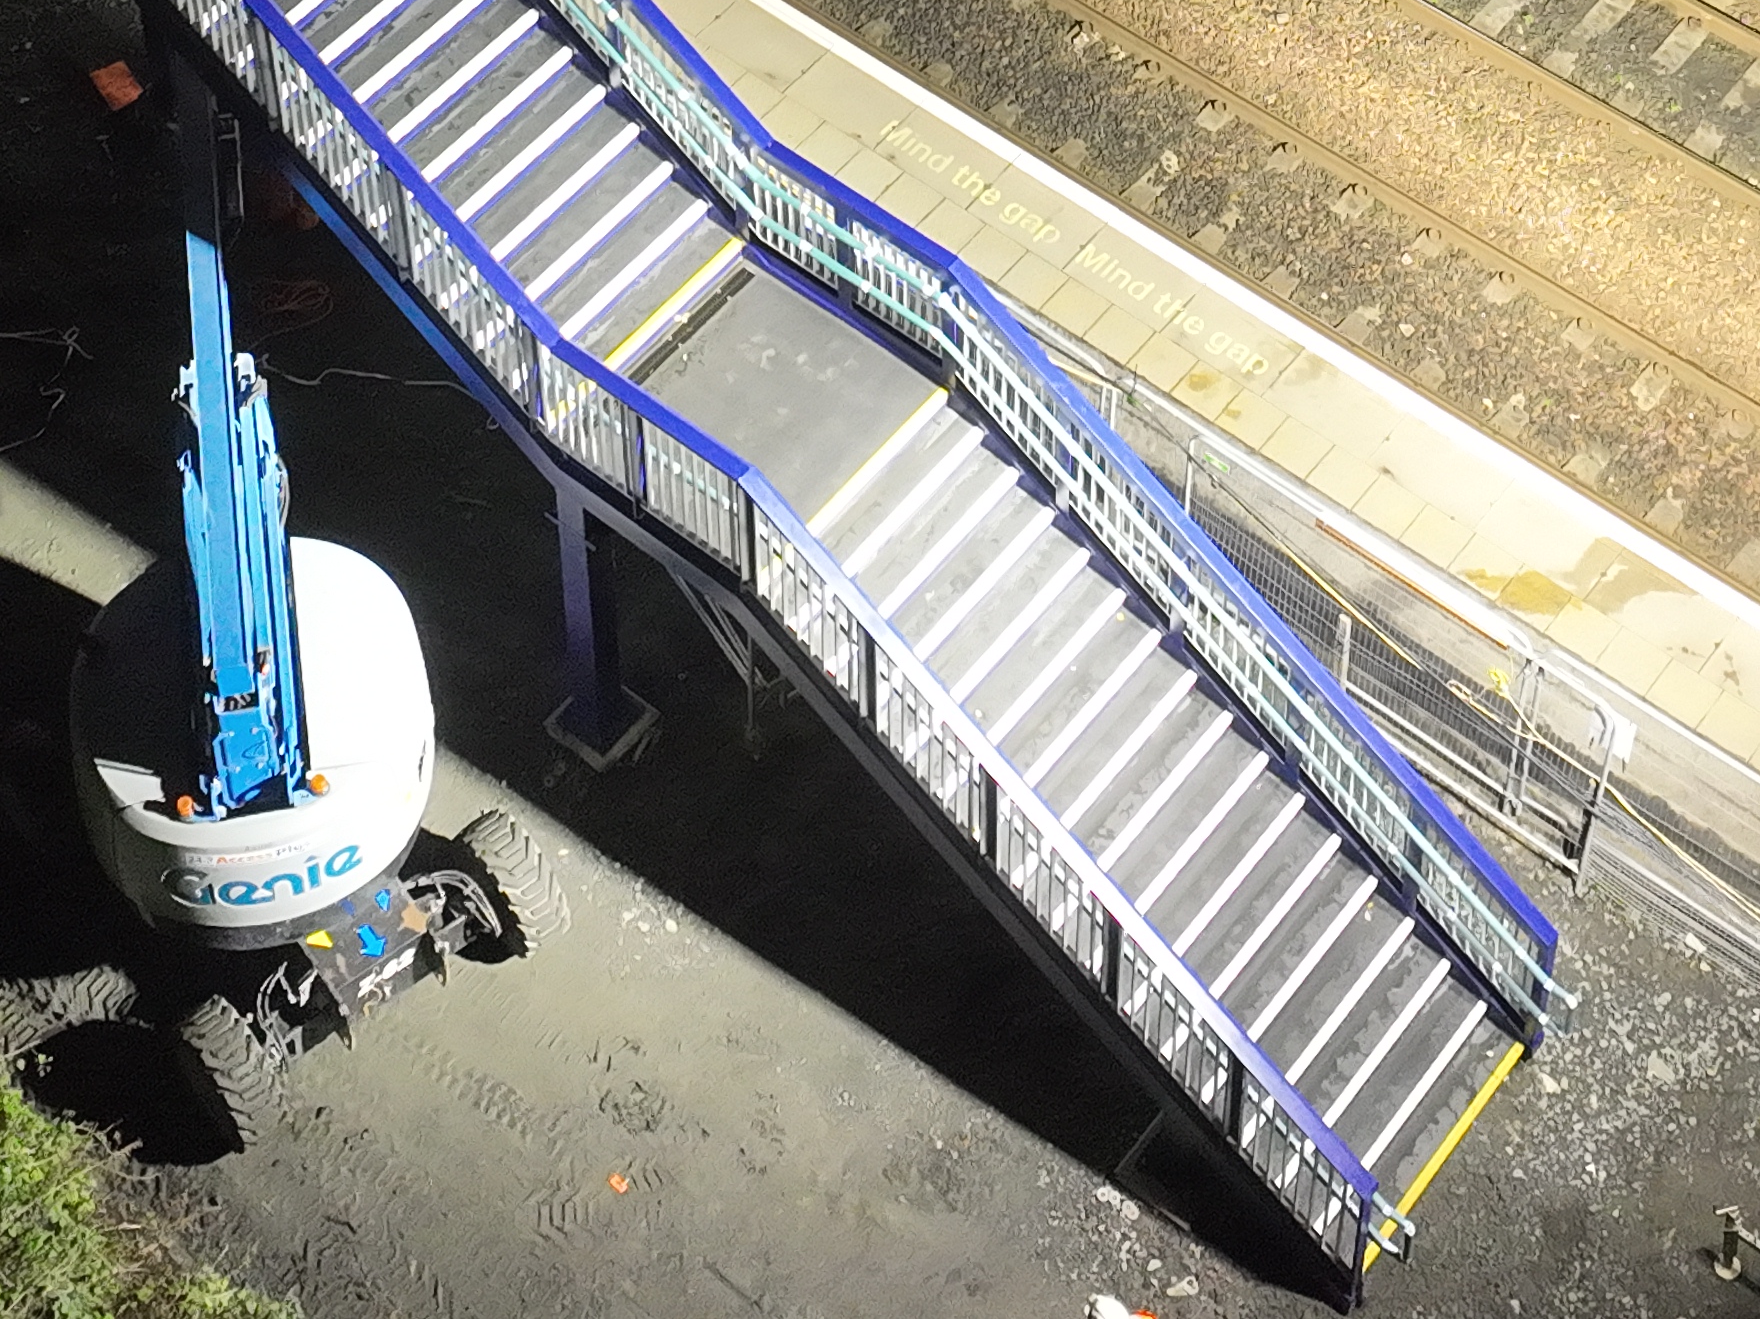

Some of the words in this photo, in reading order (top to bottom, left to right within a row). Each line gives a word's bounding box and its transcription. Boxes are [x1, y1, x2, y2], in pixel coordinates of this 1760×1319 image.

[879, 120, 955, 174] Mind
[951, 164, 1002, 206] the
[998, 202, 1061, 244] gap
[1074, 243, 1155, 301] Mind
[1152, 292, 1205, 335] the
[1203, 331, 1269, 375] gap
[160, 844, 363, 907] Genie
